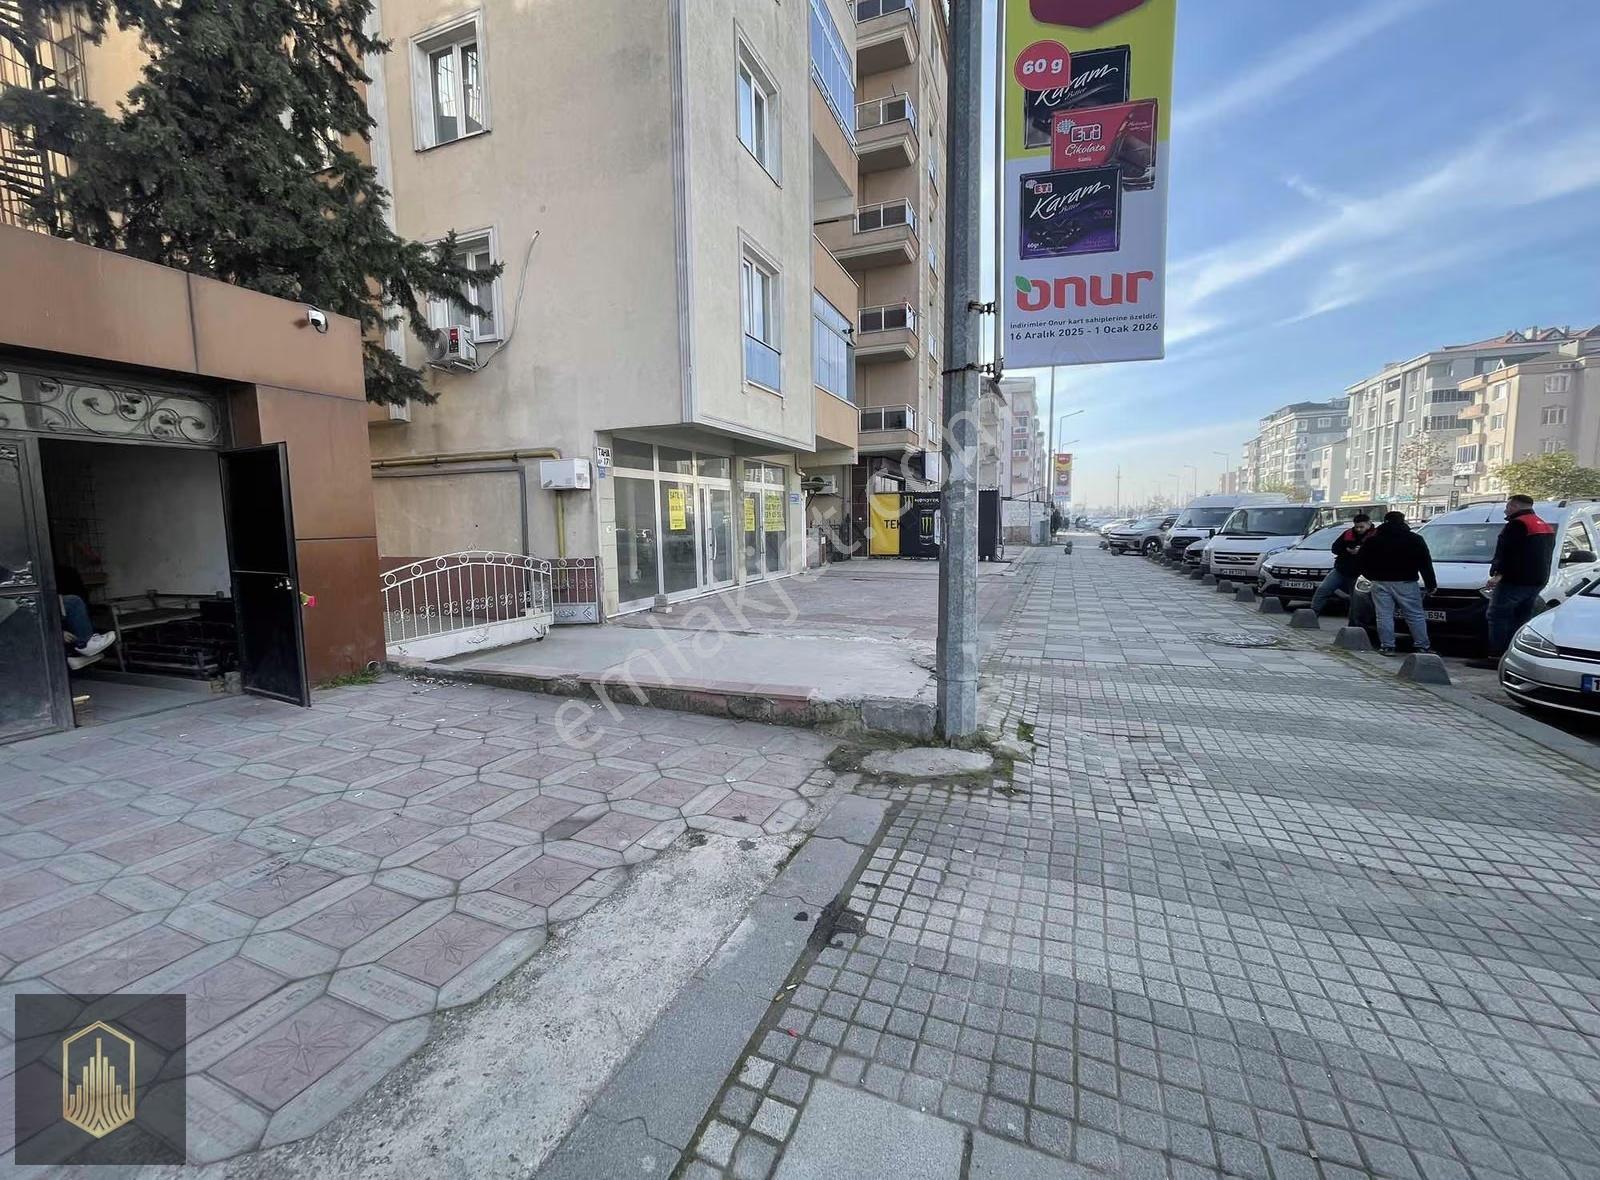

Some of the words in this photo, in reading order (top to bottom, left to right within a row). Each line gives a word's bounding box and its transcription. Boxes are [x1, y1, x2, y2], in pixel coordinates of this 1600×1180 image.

[1022, 58, 1047, 75] 60
[1051, 58, 1064, 73] g
[1034, 62, 1119, 106] Karam
[1064, 142, 1106, 158] Çikolata
[1029, 181, 1111, 220] Karam
[1068, 317, 1084, 325] kart
[1085, 315, 1128, 324] sahiplerine
[1129, 312, 1158, 321] özeldir.
[1010, 332, 1022, 341] 16
[1024, 329, 1055, 340] Aralık
[1058, 328, 1084, 337] 2025
[1103, 324, 1129, 334] Ocak
[1132, 322, 1159, 332] 2026
